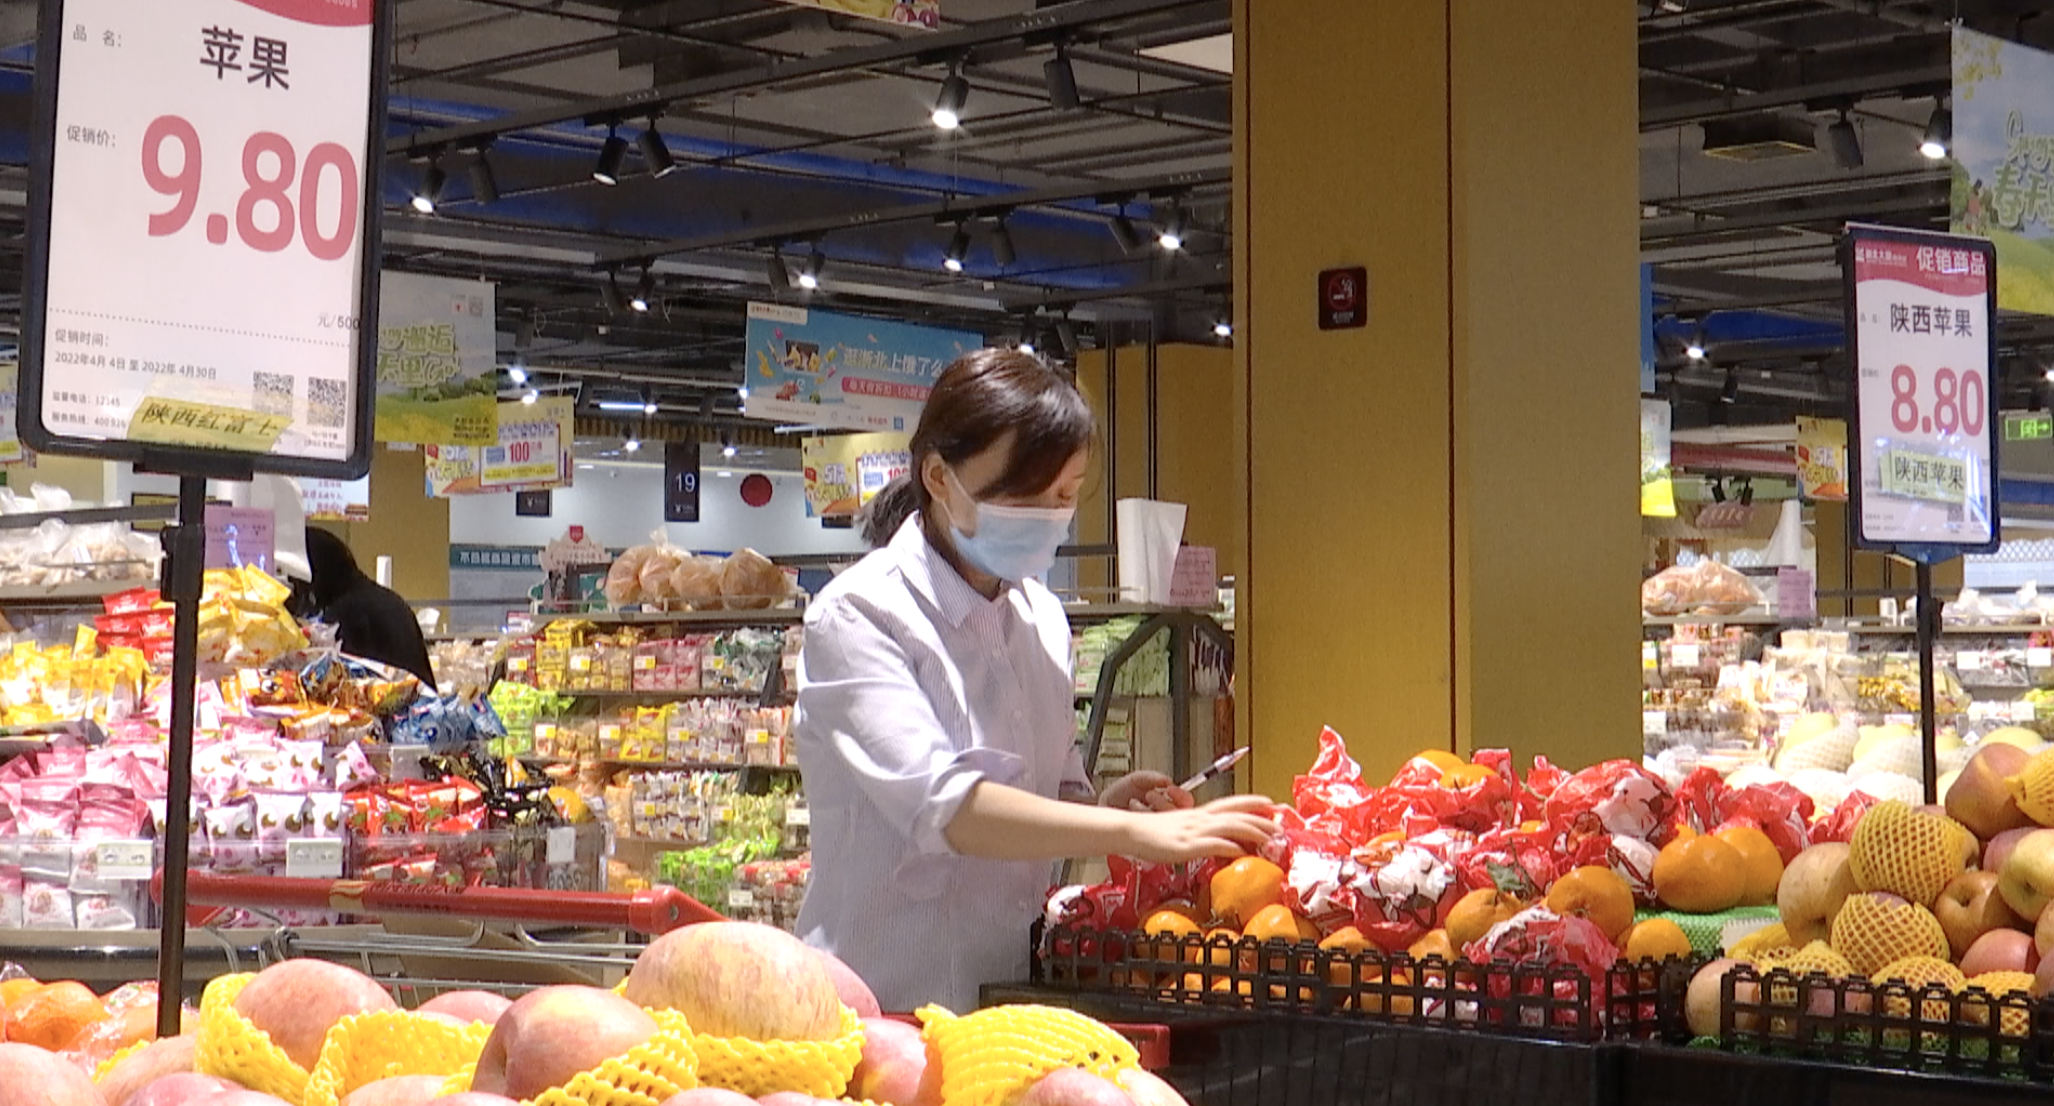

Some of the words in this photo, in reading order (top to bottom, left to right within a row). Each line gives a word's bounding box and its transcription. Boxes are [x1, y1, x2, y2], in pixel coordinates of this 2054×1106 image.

[73, 24, 87, 42] 品
[199, 25, 290, 90] 苹果
[141, 114, 358, 261] 9.80
[1916, 246, 1986, 277] 促销商品
[1890, 303, 1973, 338] 陕西苹果
[129, 360, 139, 371] 至
[142, 361, 176, 375] 2022年
[179, 365, 217, 380] 4月30日
[1891, 364, 1984, 437] 8.80
[141, 401, 279, 438] 陕西红富士
[508, 441, 530, 463] 100
[675, 472, 696, 493] 19
[1894, 456, 1965, 490] 陕西苹果
